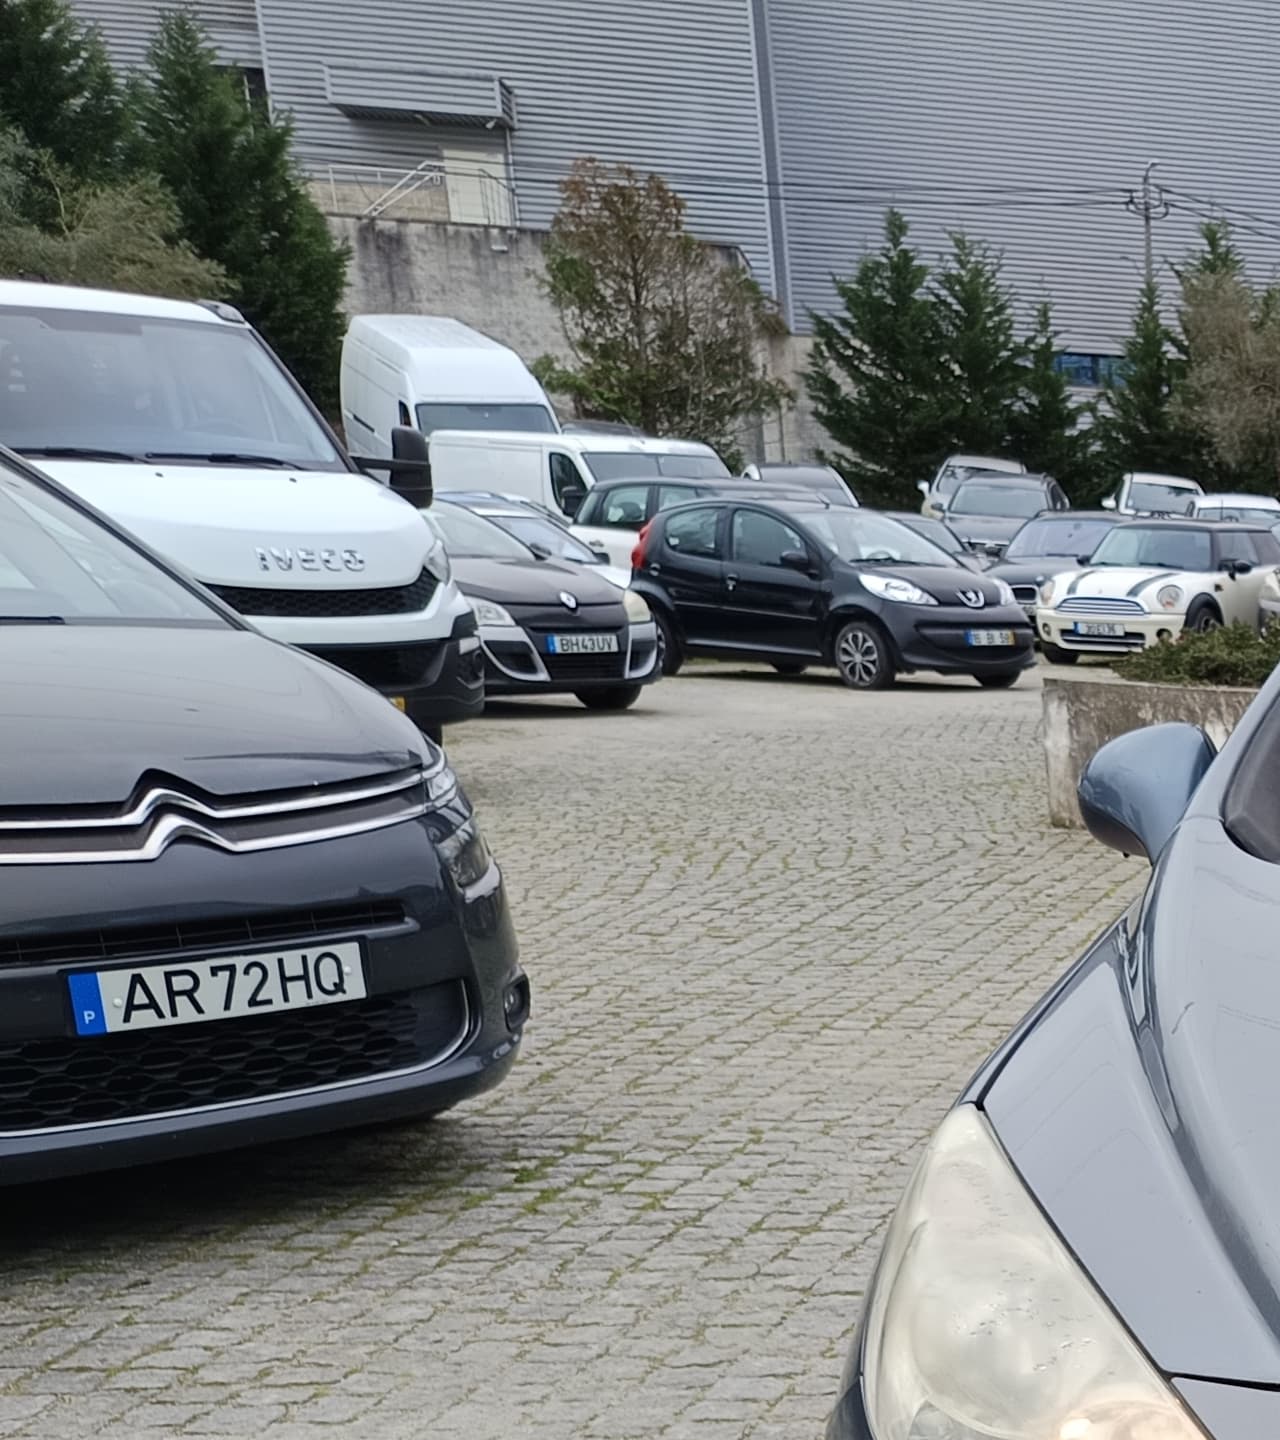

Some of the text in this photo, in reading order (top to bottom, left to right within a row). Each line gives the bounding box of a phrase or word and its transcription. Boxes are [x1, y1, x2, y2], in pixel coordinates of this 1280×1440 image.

[255, 546, 365, 572] IVECO
[122, 951, 347, 1024] AR72HQ
[83, 1010, 95, 1025] P
